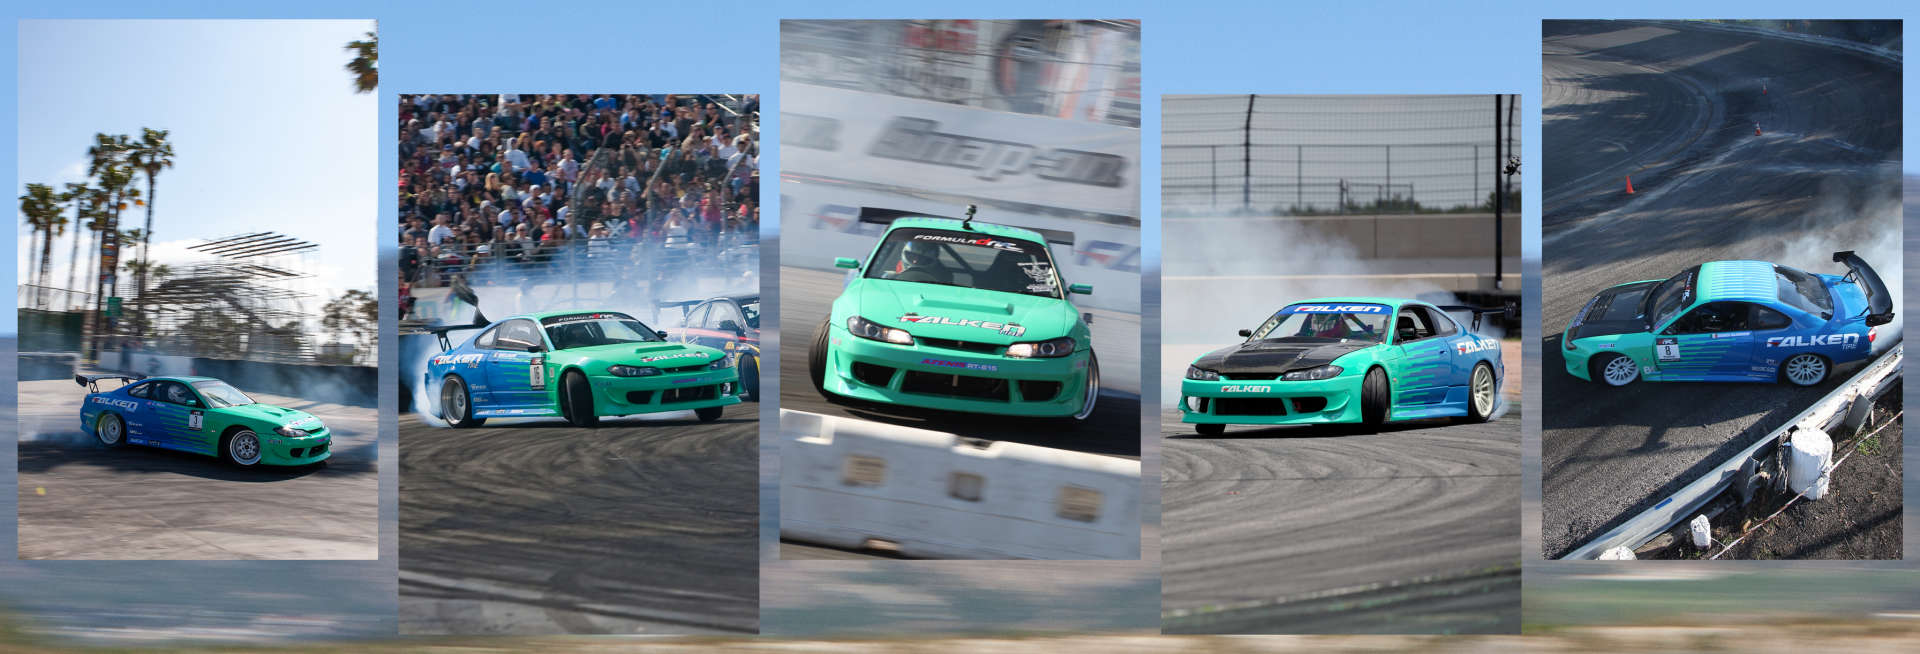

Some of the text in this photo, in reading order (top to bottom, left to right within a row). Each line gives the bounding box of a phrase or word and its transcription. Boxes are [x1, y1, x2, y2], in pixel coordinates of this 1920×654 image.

[1294, 305, 1382, 313] FALKEN
[899, 314, 1026, 337] FALKEN
[1767, 333, 1860, 348] FALKEN
[1664, 345, 1672, 356] 8
[1220, 385, 1271, 393] FALKEN
